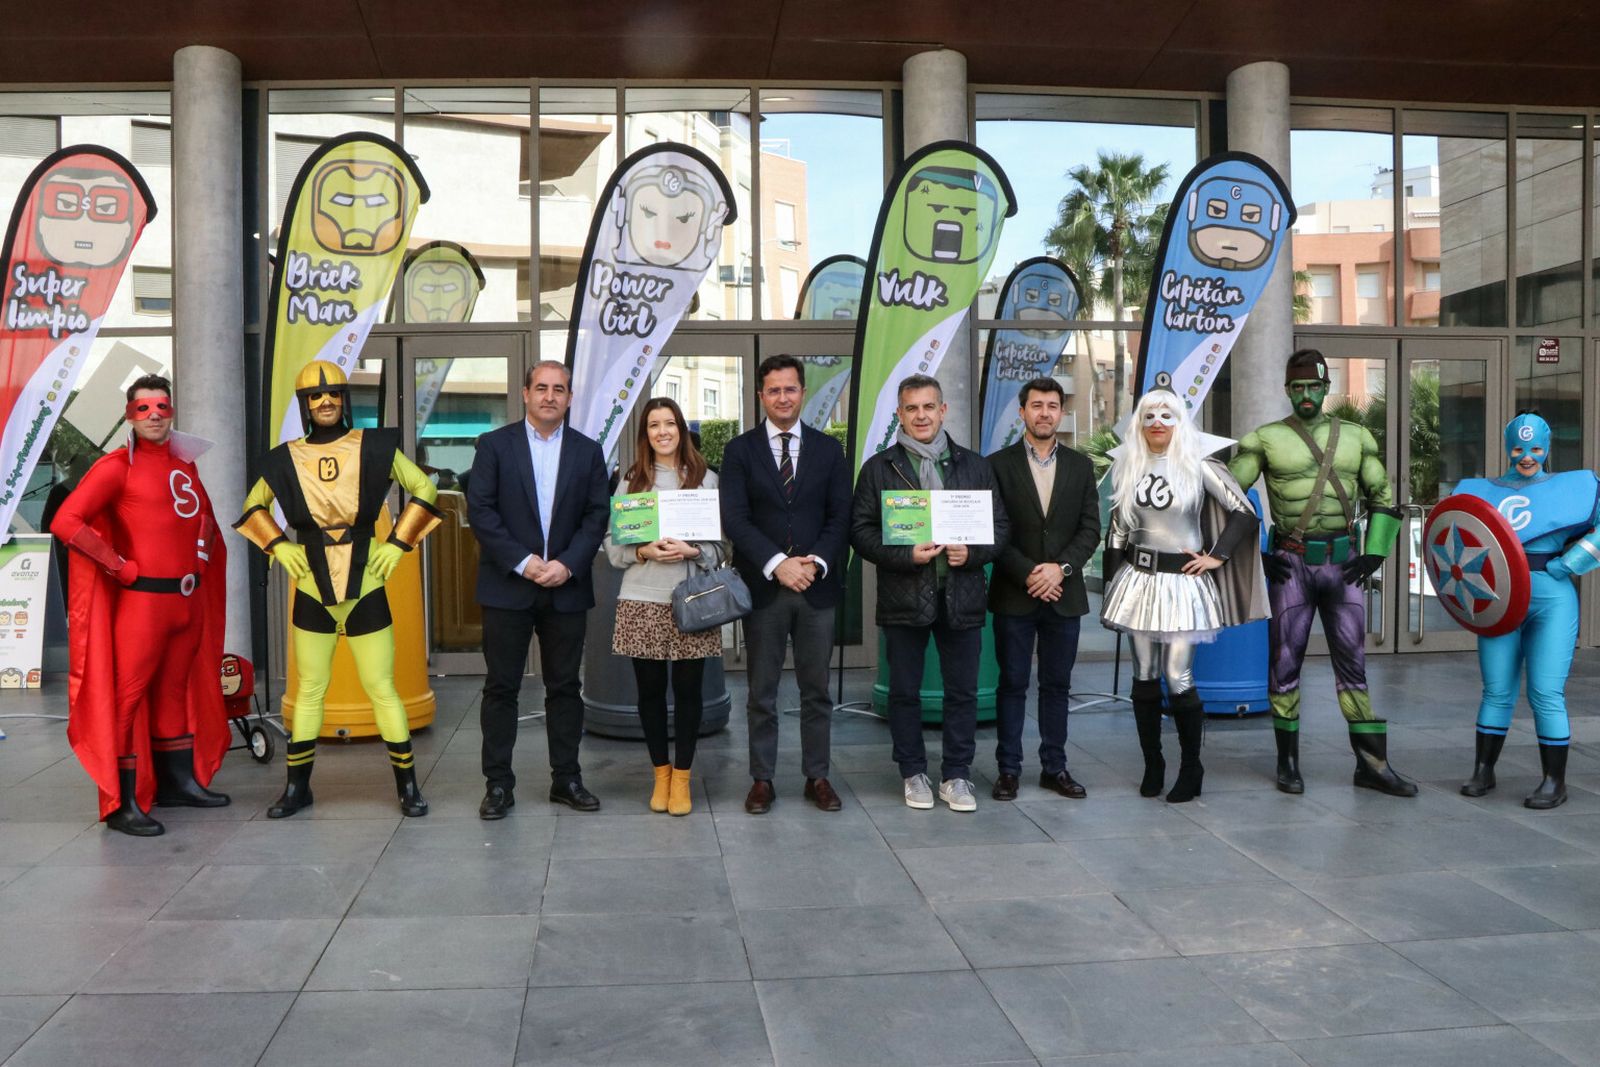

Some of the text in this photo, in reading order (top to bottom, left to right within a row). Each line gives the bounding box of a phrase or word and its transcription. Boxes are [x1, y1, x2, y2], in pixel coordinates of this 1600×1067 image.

[1230, 185, 1241, 200] C
[14, 264, 87, 305] Super
[287, 251, 360, 290] Brick
[592, 262, 671, 299] Power
[878, 271, 946, 308] Vulk
[1161, 271, 1243, 308] Capitán
[289, 294, 354, 323] Man
[601, 301, 655, 336] Girl
[1164, 301, 1233, 332] Cartón
[994, 339, 1050, 364] Capitán
[319, 456, 339, 482] B
[169, 469, 200, 518] S
[1136, 473, 1174, 511] PG
